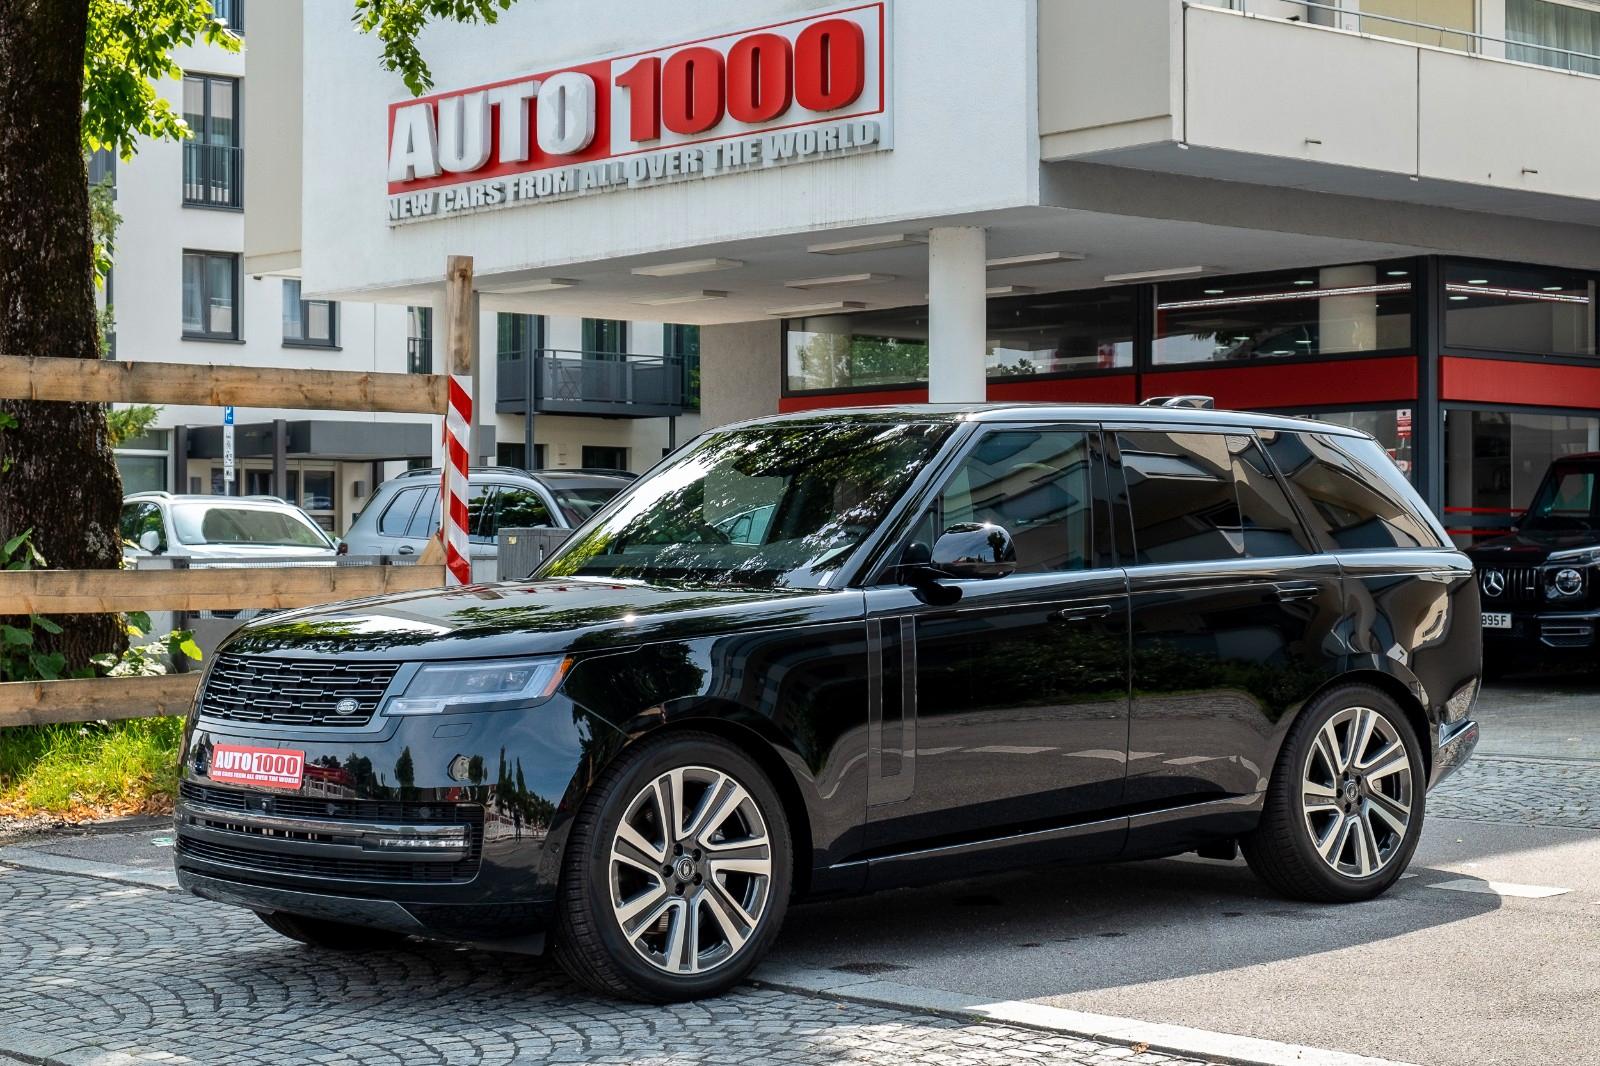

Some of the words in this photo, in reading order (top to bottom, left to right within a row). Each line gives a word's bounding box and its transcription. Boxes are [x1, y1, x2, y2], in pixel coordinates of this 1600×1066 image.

[387, 191, 433, 220] NEW
[438, 181, 505, 212] CARS
[506, 168, 575, 202] FROM
[580, 161, 626, 190] ALL
[633, 150, 702, 181] OVER
[706, 139, 761, 169] THE
[763, 121, 880, 160] WORLD
